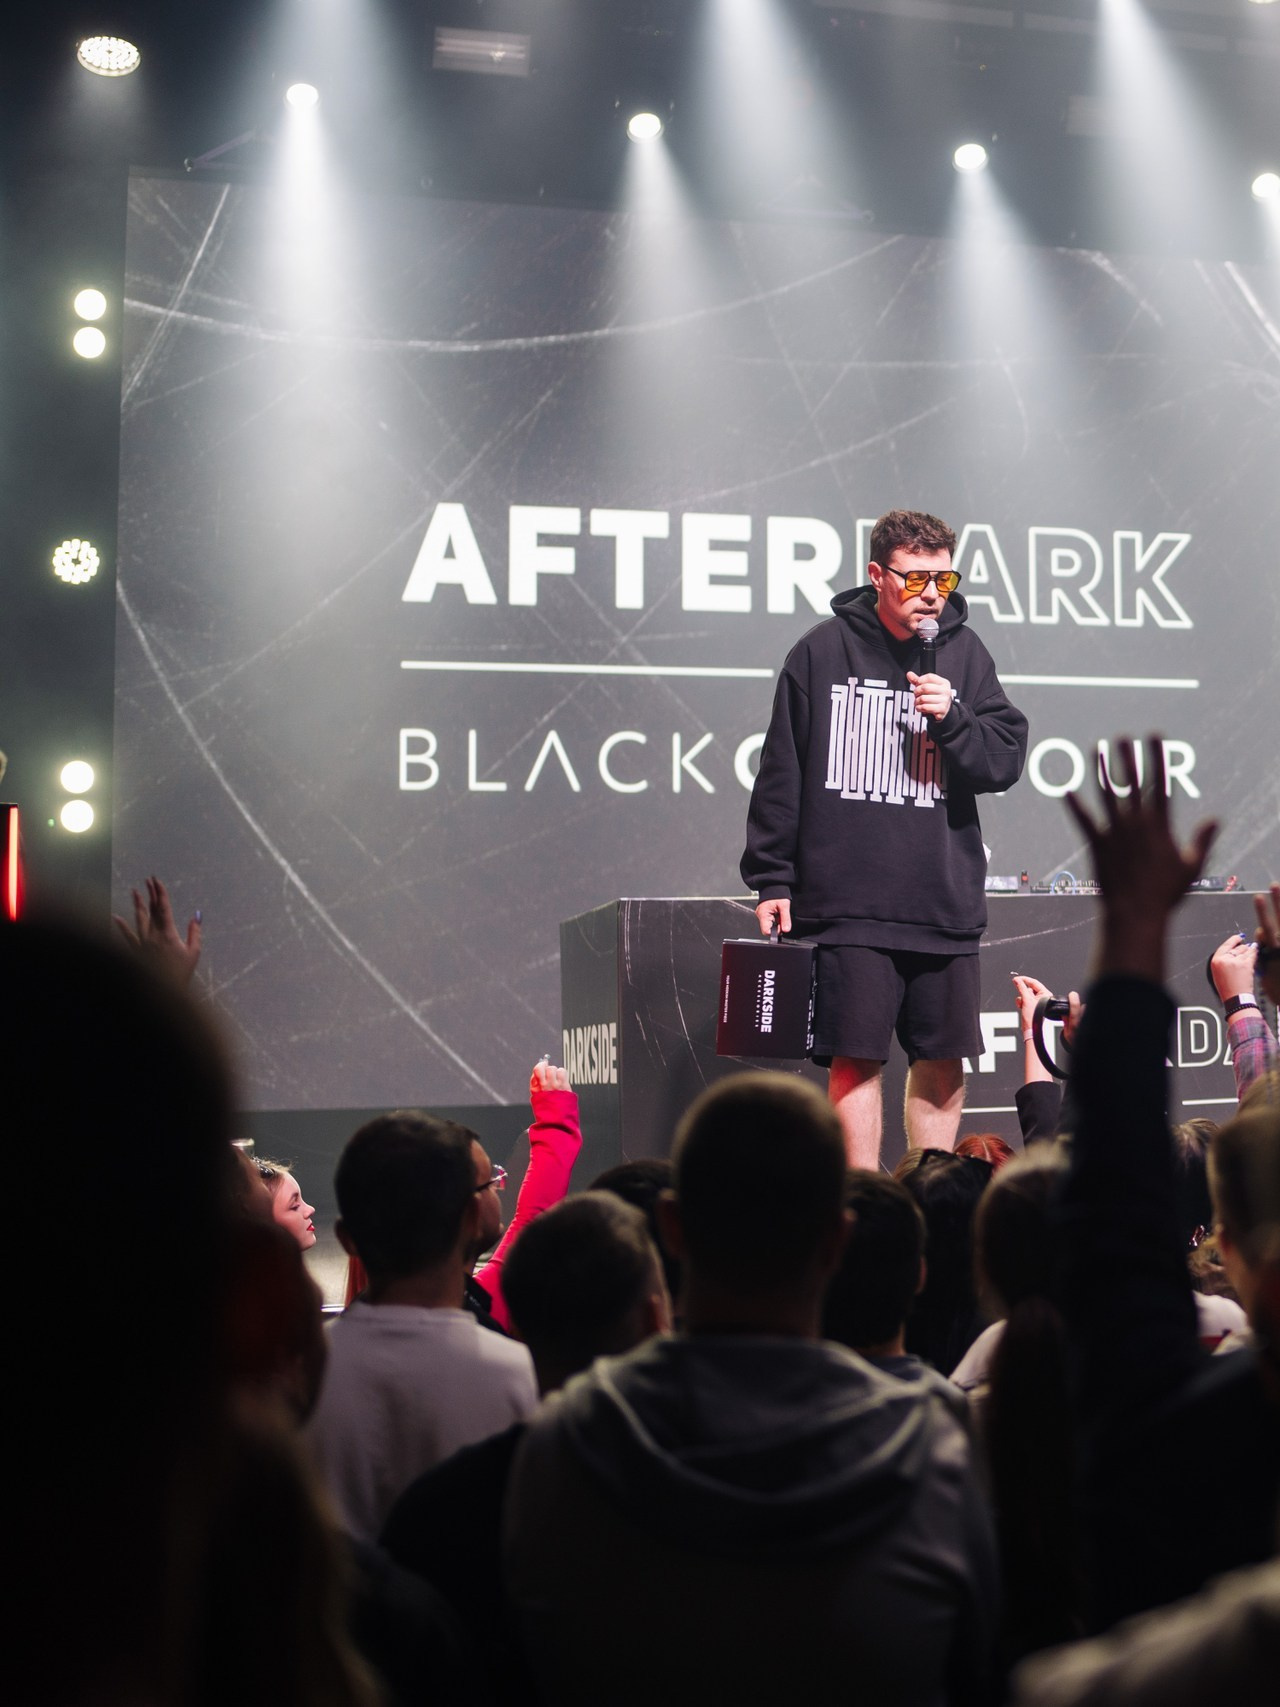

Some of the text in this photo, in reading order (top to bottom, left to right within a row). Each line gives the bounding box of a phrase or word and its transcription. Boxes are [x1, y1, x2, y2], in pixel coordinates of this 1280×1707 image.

[996, 738, 1201, 799] OUR
[760, 969, 776, 1033] DARKSIDE
[562, 1022, 618, 1085] DARKSIDE
